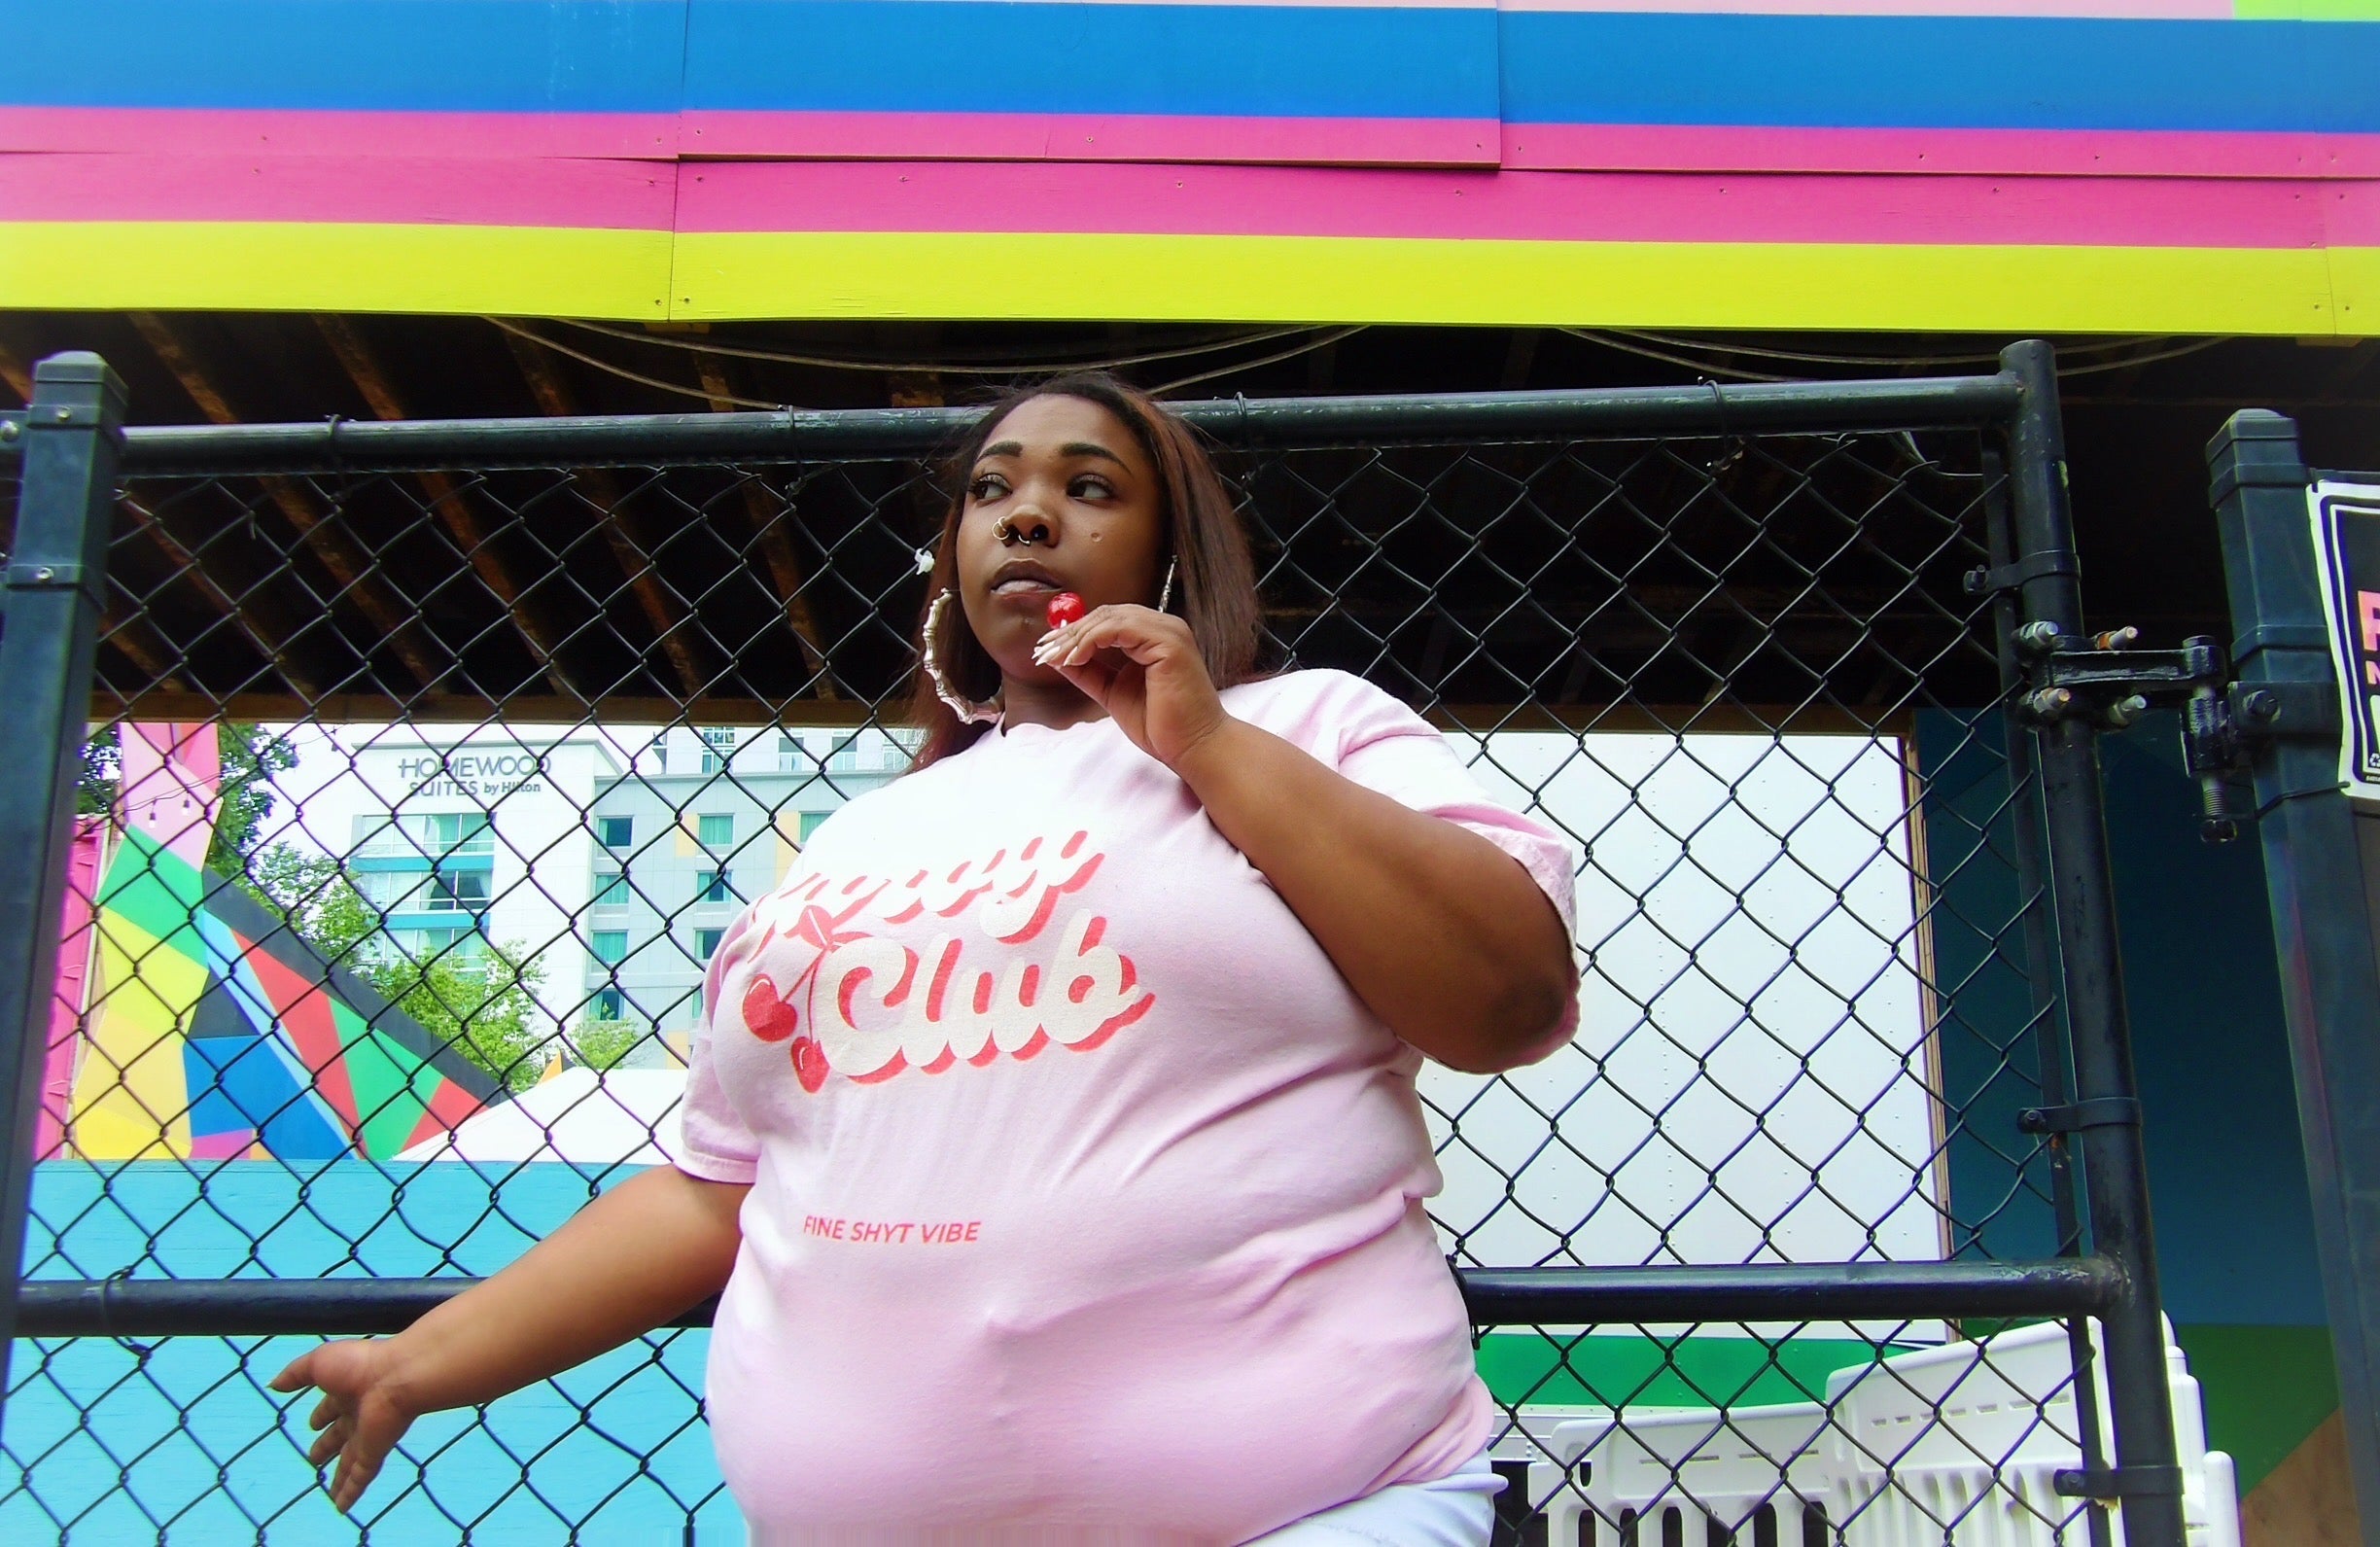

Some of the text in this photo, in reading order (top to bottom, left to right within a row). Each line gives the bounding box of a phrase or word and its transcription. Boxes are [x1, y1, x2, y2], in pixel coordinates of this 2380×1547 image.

[409, 781, 478, 796] SUITES
[484, 782, 499, 795] by
[818, 908, 1155, 1085] Club
[803, 1214, 982, 1244] FINE SHYT VIBE
